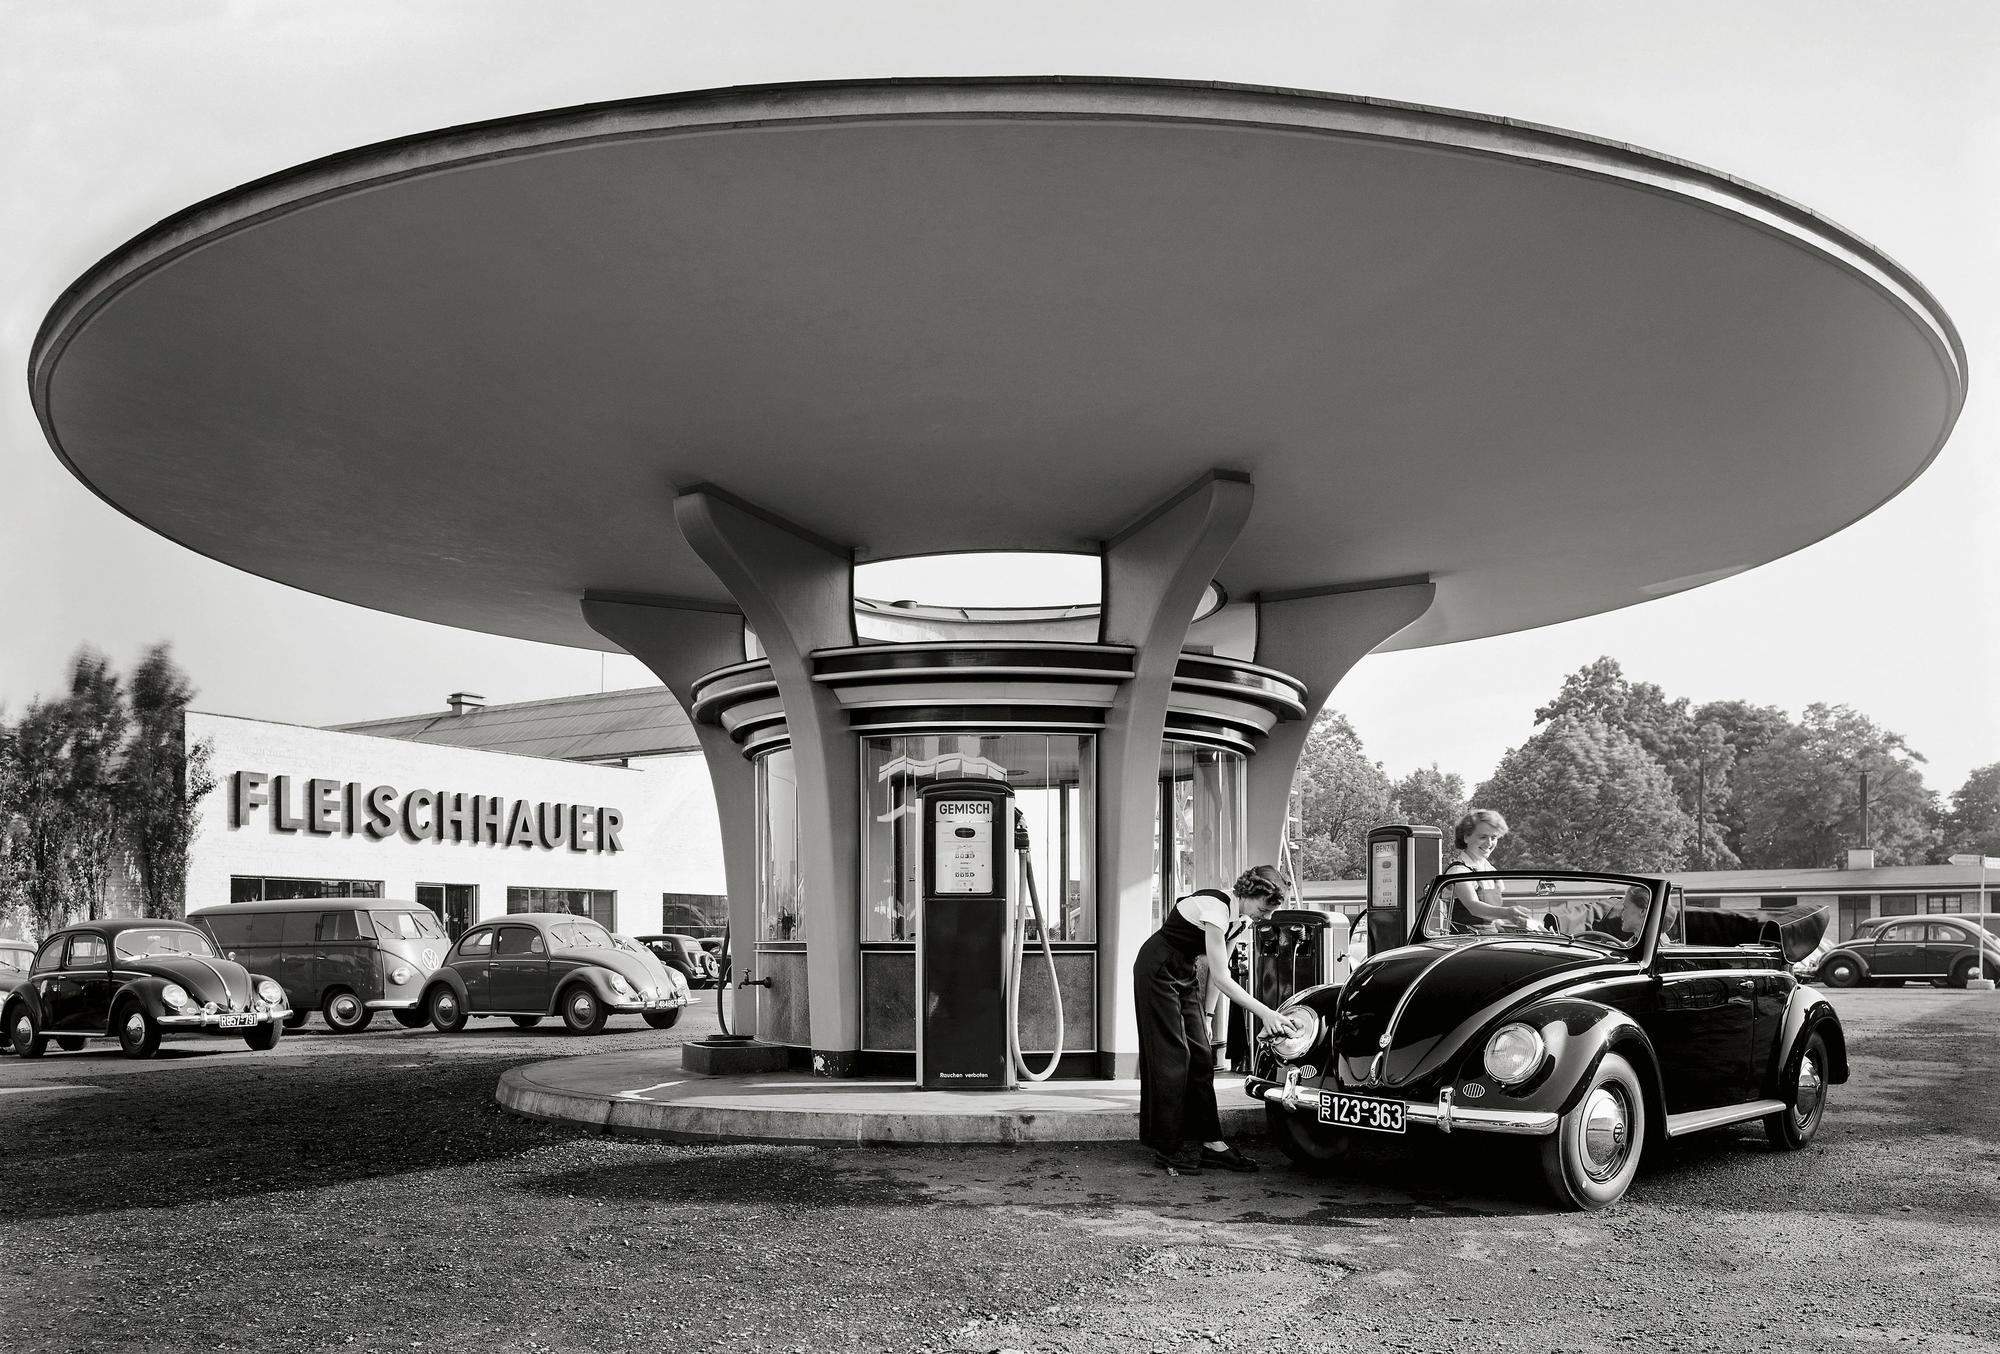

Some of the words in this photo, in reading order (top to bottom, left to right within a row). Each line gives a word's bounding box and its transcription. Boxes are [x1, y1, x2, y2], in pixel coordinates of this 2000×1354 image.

[234, 770, 624, 853] FLEISCHHAUER
[939, 803, 990, 815] GEMISCH
[1375, 844, 1396, 853] BENZIN
